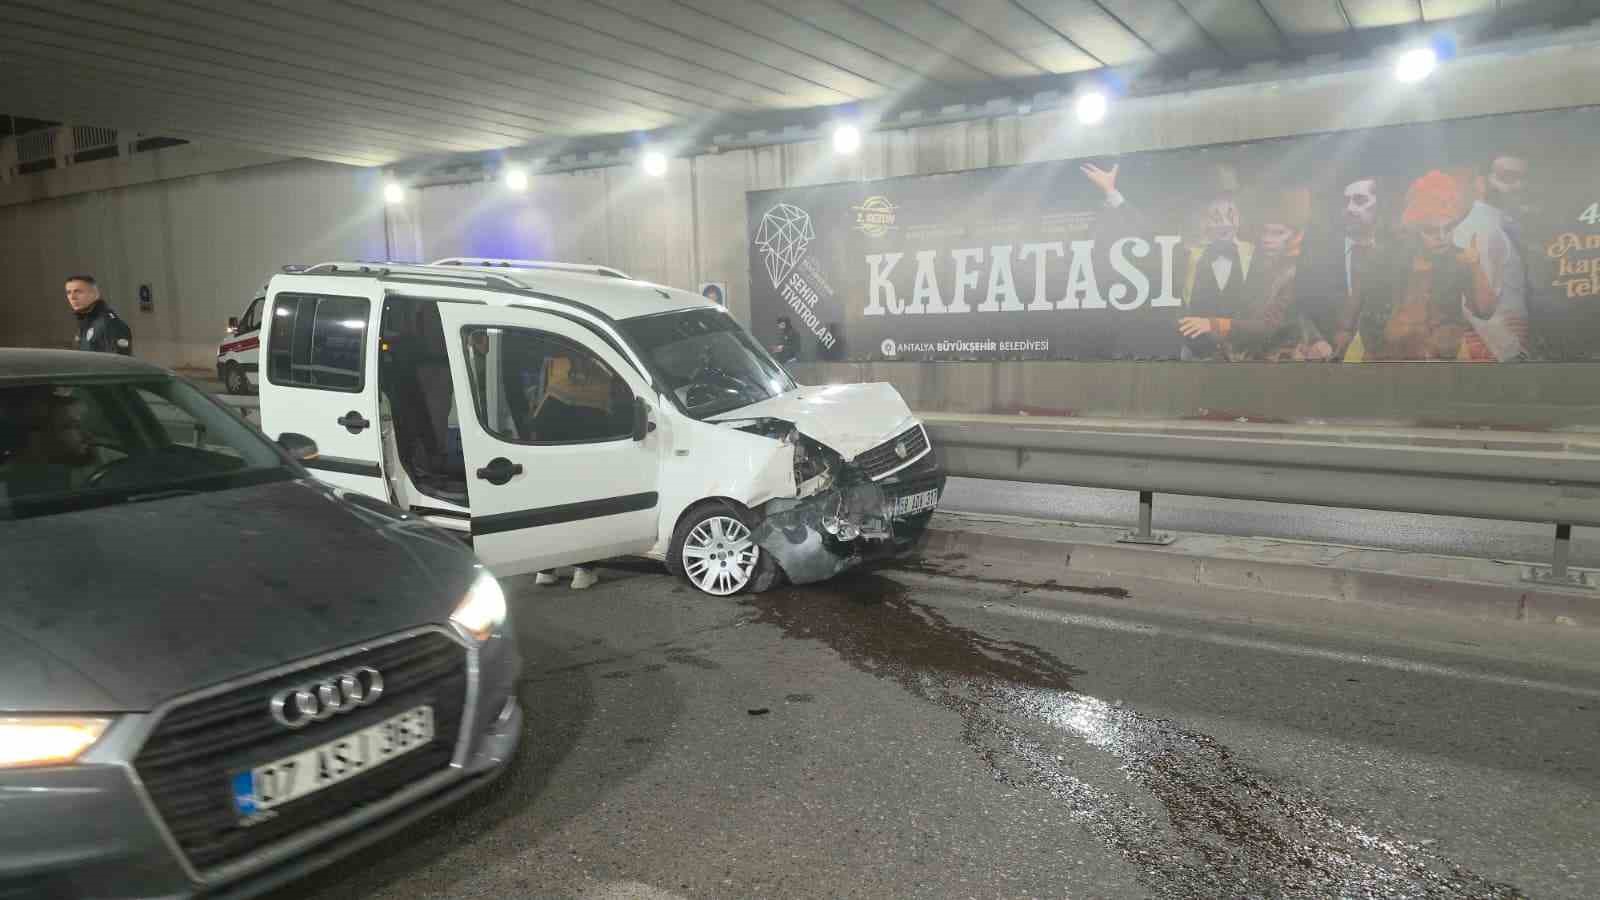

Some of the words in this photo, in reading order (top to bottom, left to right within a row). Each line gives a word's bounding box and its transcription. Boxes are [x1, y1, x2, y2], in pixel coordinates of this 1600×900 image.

[863, 235, 1182, 316] KAFATASI
[896, 342, 936, 353] ANTALYA
[937, 339, 997, 353] BÜYÜKŞEHİR
[999, 338, 1049, 352] BELEDİYESİ
